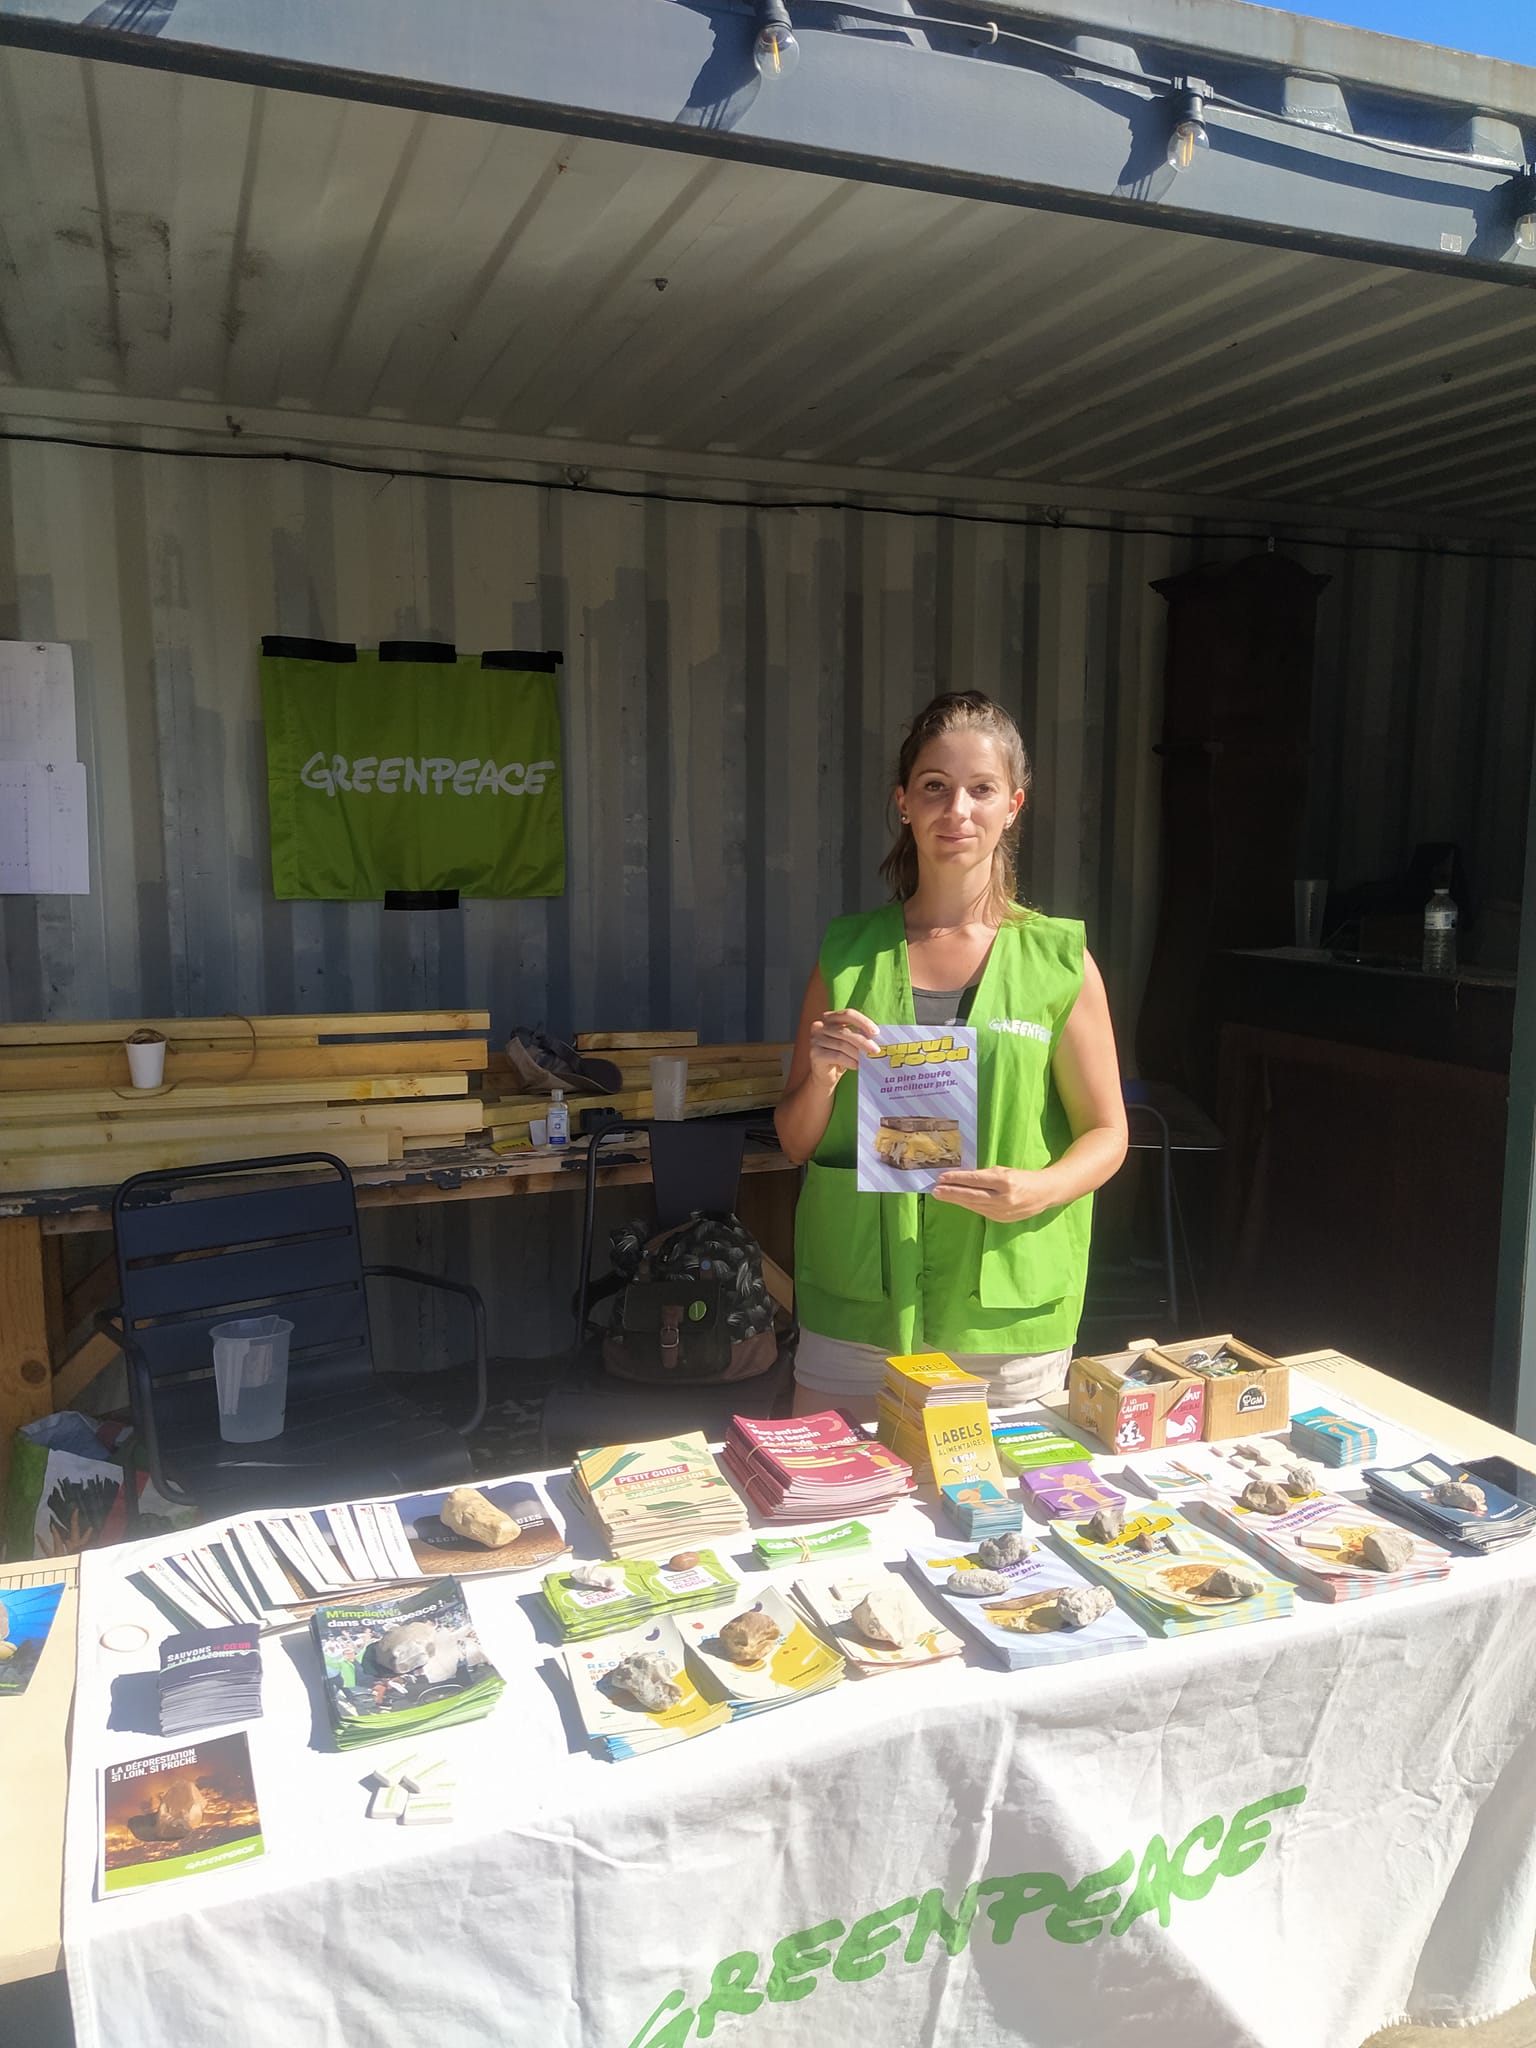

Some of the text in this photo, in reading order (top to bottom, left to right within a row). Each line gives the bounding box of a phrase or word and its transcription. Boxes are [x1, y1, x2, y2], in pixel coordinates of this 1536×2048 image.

[300, 751, 555, 797] GREENPEACE
[889, 1047, 969, 1068] food
[880, 1079, 958, 1094] au meilleur prix.
[884, 1070, 951, 1085] La pire bouffe
[934, 1423, 983, 1447] LABELS
[938, 1438, 986, 1456] ALIMENTAIRES
[619, 1465, 685, 1484] PETIT GUIDE
[328, 1618, 359, 1628] dans
[361, 1604, 437, 1627] Greenpeace
[167, 1645, 212, 1663] SAUVONS
[111, 1748, 196, 1776] LA DÉFORESTATION
[111, 1773, 121, 1783] SI
[149, 1765, 160, 1774] SI
[161, 1755, 198, 1771] PROCHE
